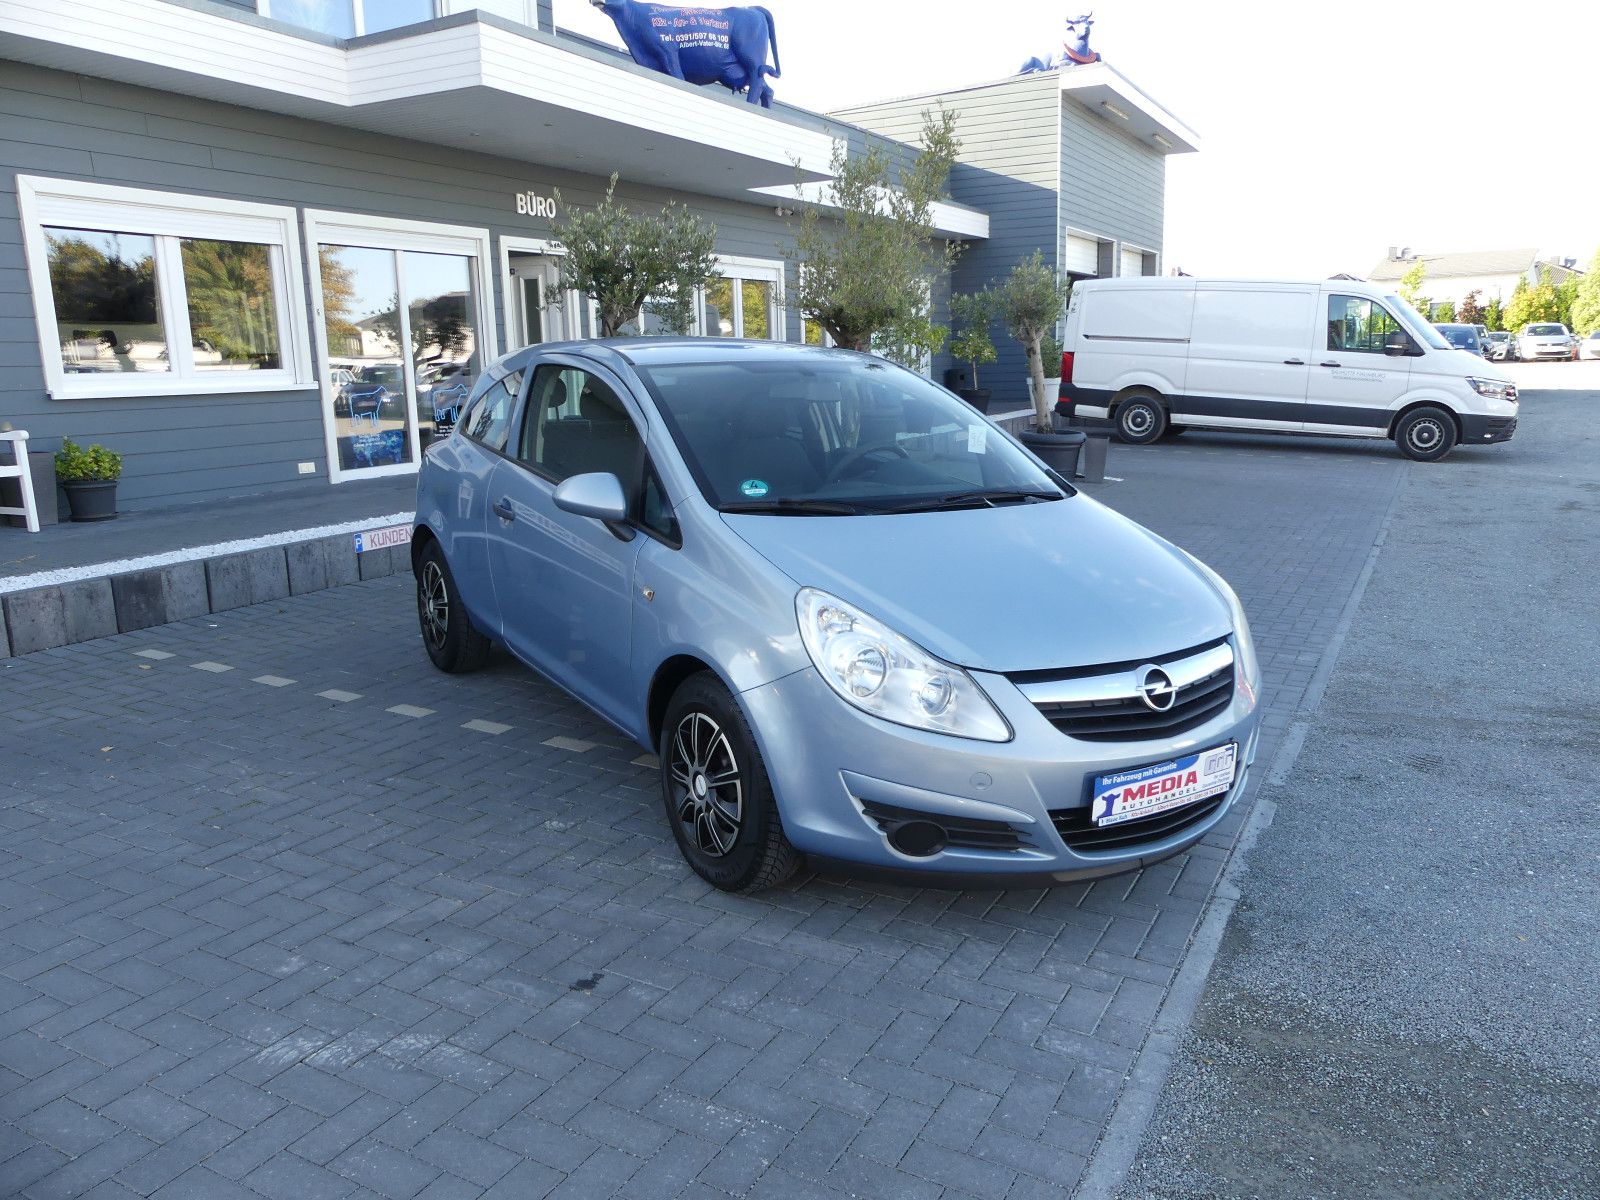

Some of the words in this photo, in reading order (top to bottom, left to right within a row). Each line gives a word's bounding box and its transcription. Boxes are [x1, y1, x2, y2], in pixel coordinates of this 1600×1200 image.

[660, 34, 674, 42] Tel.
[675, 32, 707, 42] 0391/597
[718, 35, 729, 43] 100
[516, 190, 556, 219] BÜRO
[370, 527, 413, 548] KUNDEN
[1102, 777, 1112, 785] Ihr
[1112, 771, 1142, 784] Fahrzeug
[1142, 768, 1153, 777] mit
[1153, 762, 1177, 774] Garantie
[1121, 786, 1197, 811] AUTOHANDEL
[1122, 770, 1198, 803] MEDIA
